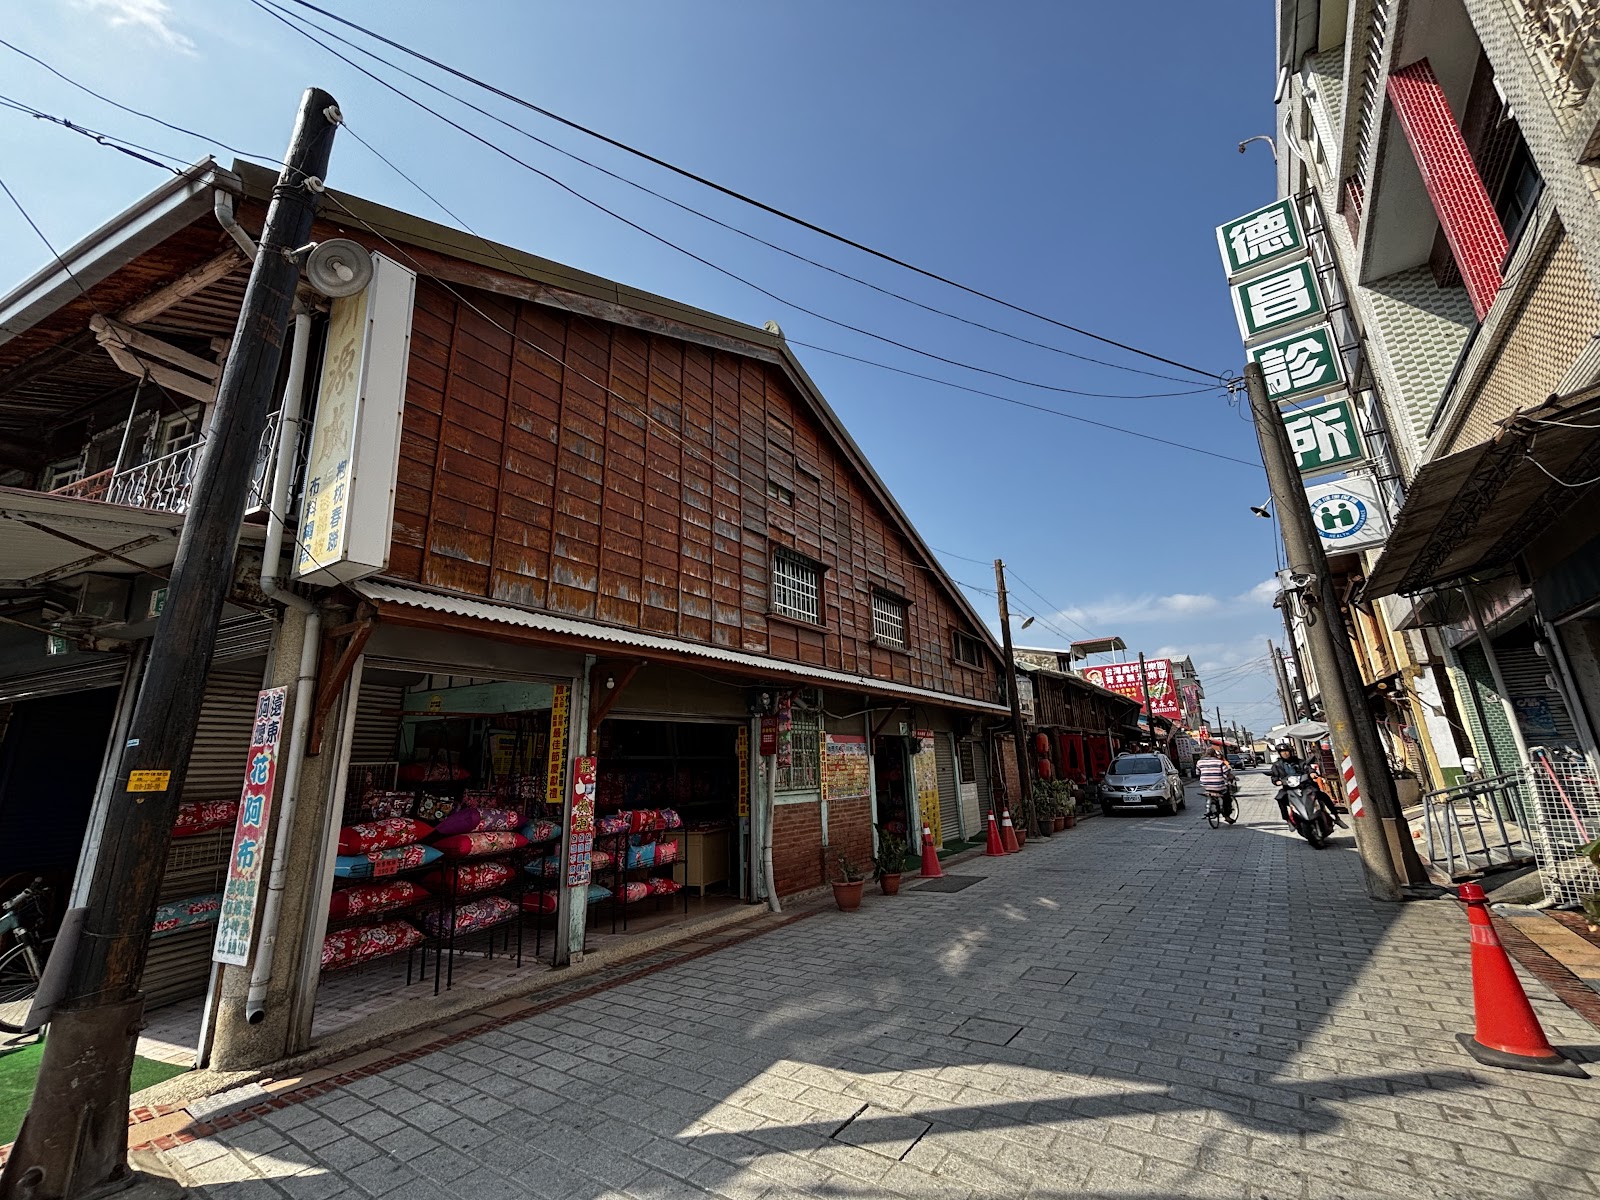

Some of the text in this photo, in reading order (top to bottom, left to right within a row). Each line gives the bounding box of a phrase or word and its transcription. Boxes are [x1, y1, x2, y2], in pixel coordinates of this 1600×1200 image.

[1229, 206, 1352, 468] 德昌診所
[237, 755, 268, 869] 花阿布
